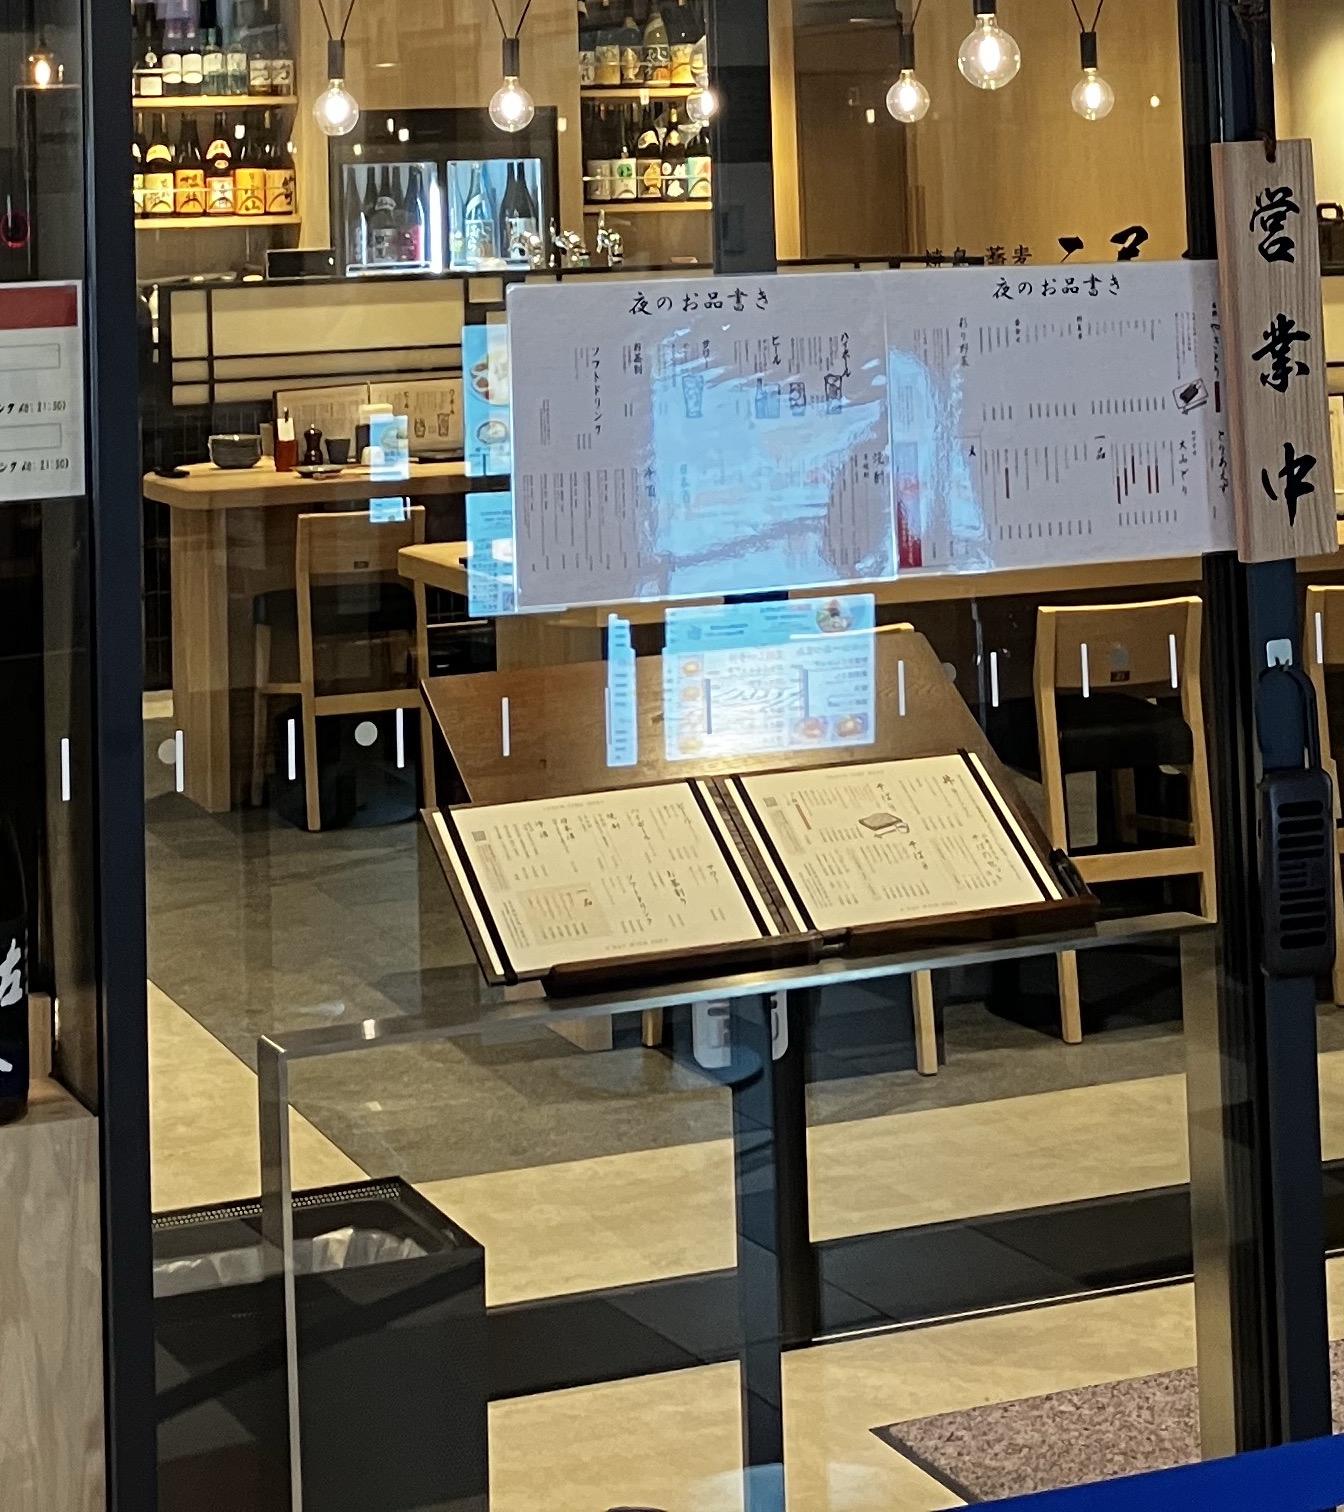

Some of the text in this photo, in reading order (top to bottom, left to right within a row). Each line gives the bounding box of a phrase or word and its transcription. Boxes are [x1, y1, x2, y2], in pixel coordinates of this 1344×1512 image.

[628, 287, 770, 316] 夜のお品書き
[992, 273, 1122, 300] 夜のお品書き
[1249, 186, 1318, 528] 営業中
[591, 346, 603, 436] ソフトドリンク
